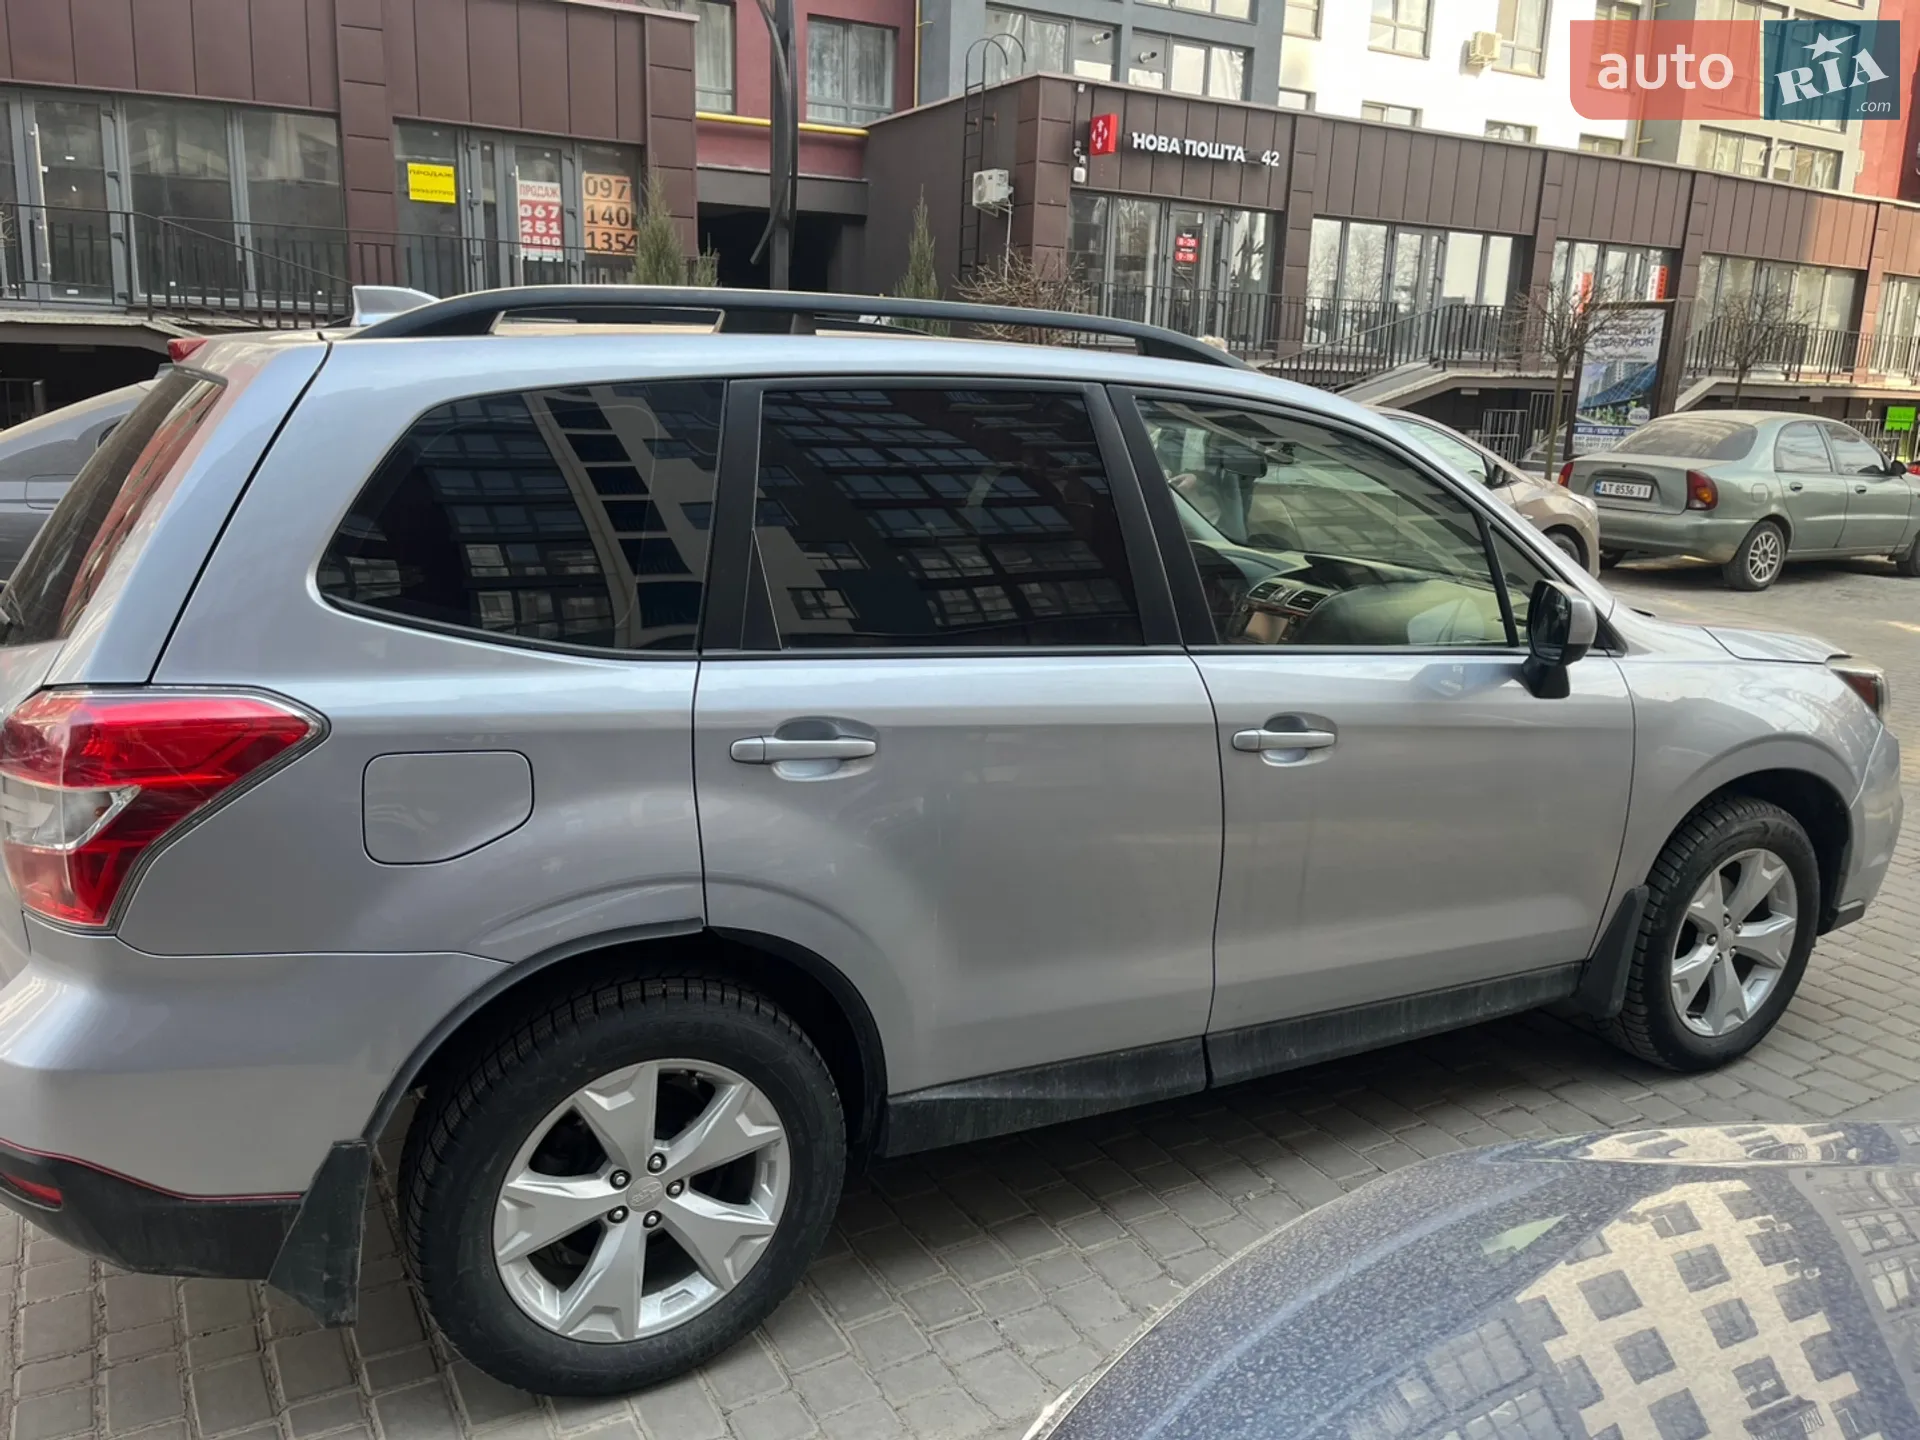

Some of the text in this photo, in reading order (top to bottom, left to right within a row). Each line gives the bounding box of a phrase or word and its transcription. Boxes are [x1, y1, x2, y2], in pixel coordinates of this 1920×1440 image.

[1131, 131, 1280, 167] НОВА ПОШТА 42
[409, 168, 454, 178] ПРОДАЖ
[519, 183, 560, 197] ПРОДАЖ
[584, 175, 630, 200] 097
[520, 204, 560, 219] 067
[585, 204, 630, 227] 140
[521, 219, 561, 235] 251
[522, 235, 561, 246] 0500
[586, 230, 638, 252] 1354
[1602, 483, 1614, 493] AT
